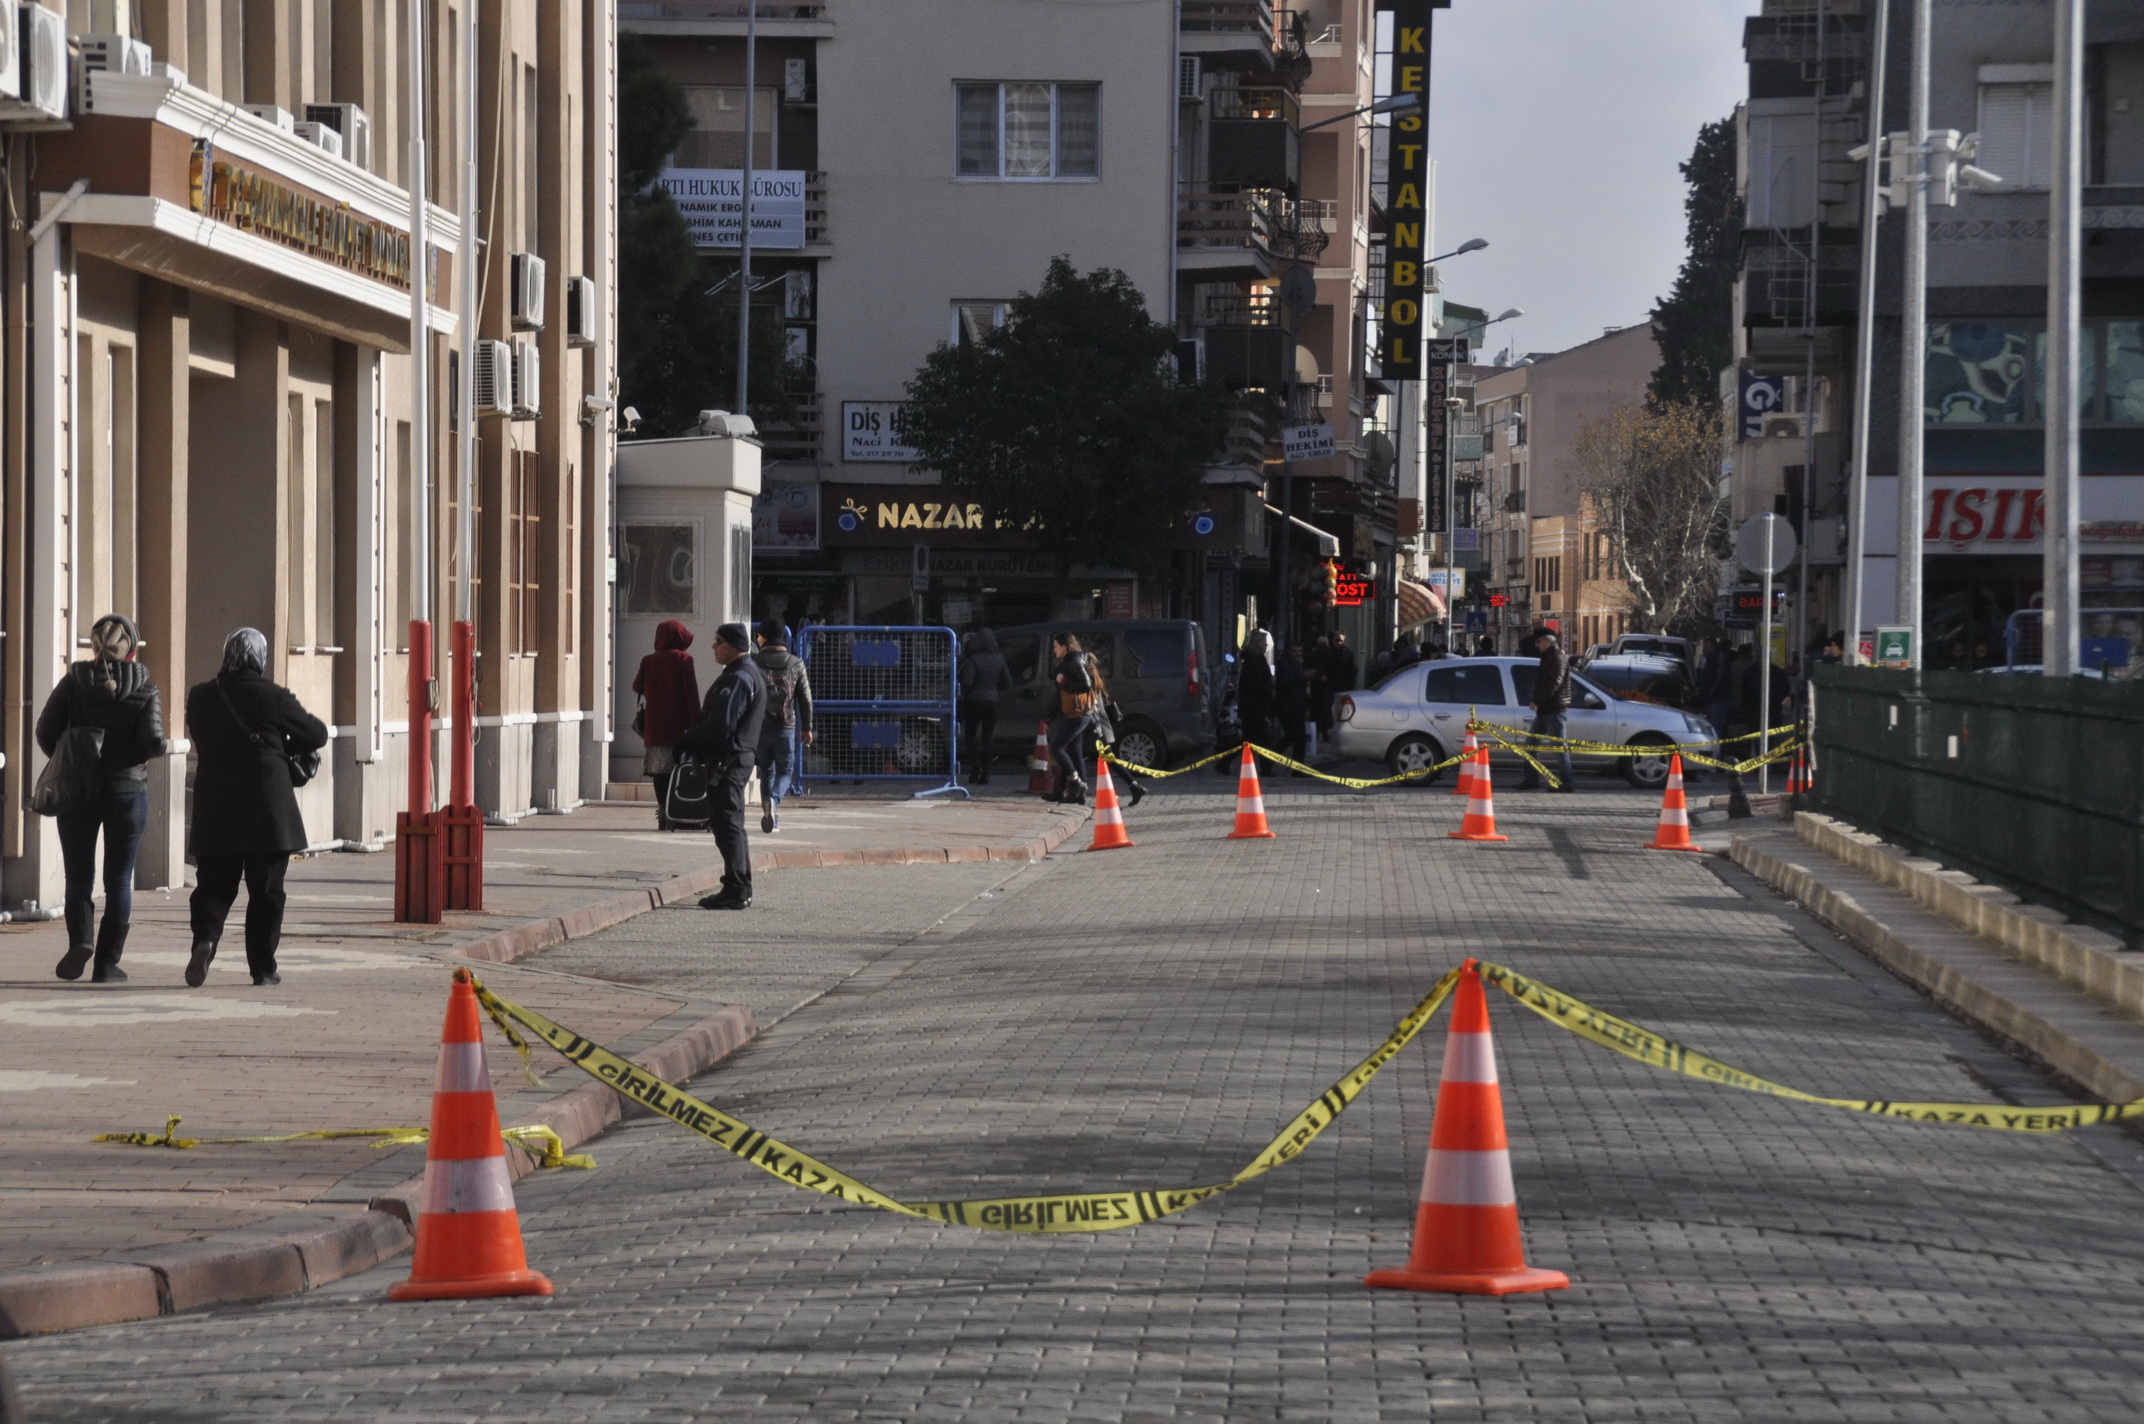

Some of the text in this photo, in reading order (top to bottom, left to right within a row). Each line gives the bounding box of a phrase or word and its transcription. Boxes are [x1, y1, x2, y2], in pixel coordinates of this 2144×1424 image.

[689, 180, 740, 196] HUKUK
[750, 177, 801, 198] ÜROSU
[1391, 26, 1425, 364] KESTANBOL
[680, 203, 718, 212] NAMIK
[718, 219, 781, 228] KAHAMAN
[851, 407, 881, 436] DİŞ
[877, 502, 984, 529] NAZAR
[1894, 1108, 2082, 1129] KAZA YERİ
[597, 1064, 845, 1200] GİRİLMEZ KAZA
